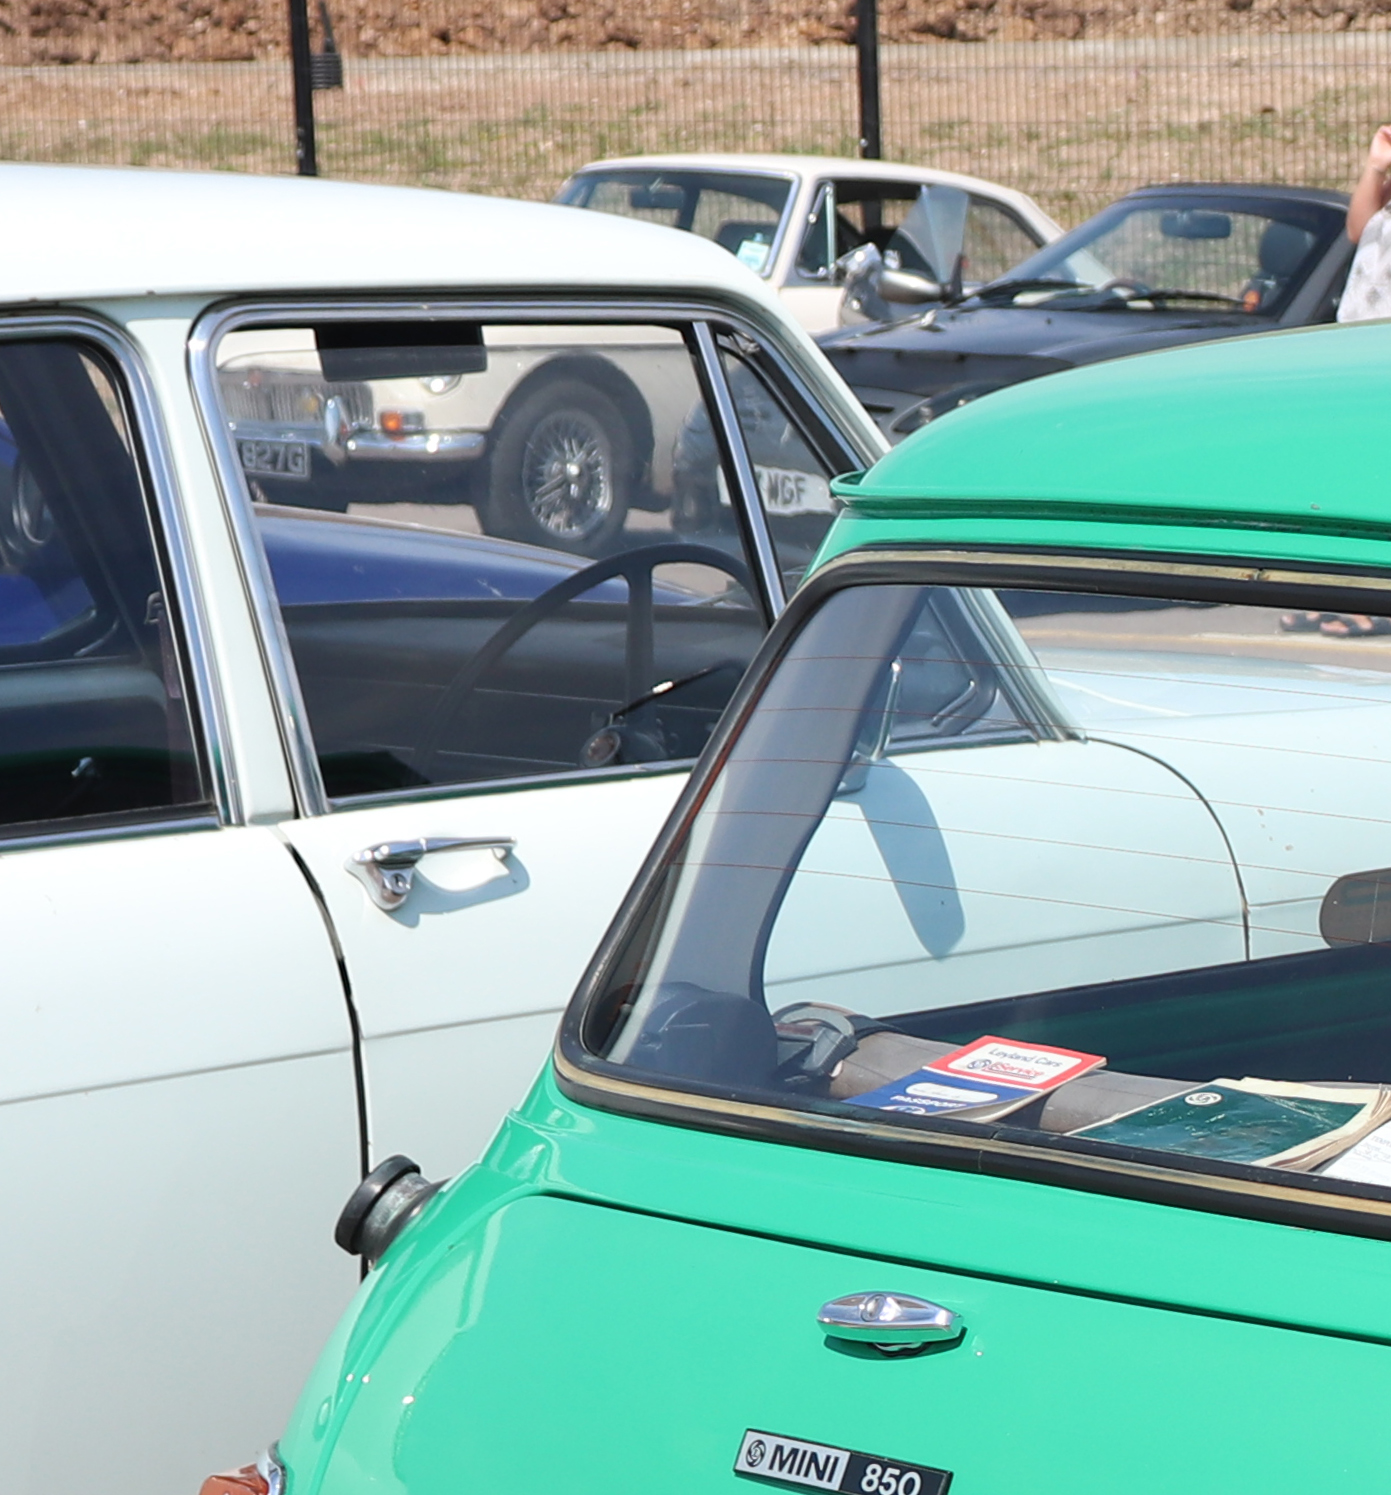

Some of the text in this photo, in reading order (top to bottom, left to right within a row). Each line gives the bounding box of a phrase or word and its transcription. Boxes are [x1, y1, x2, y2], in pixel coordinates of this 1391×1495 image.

[242, 441, 303, 473] 827G
[989, 1048, 1063, 1067] Leyland Cars
[768, 1444, 840, 1483] MINI
